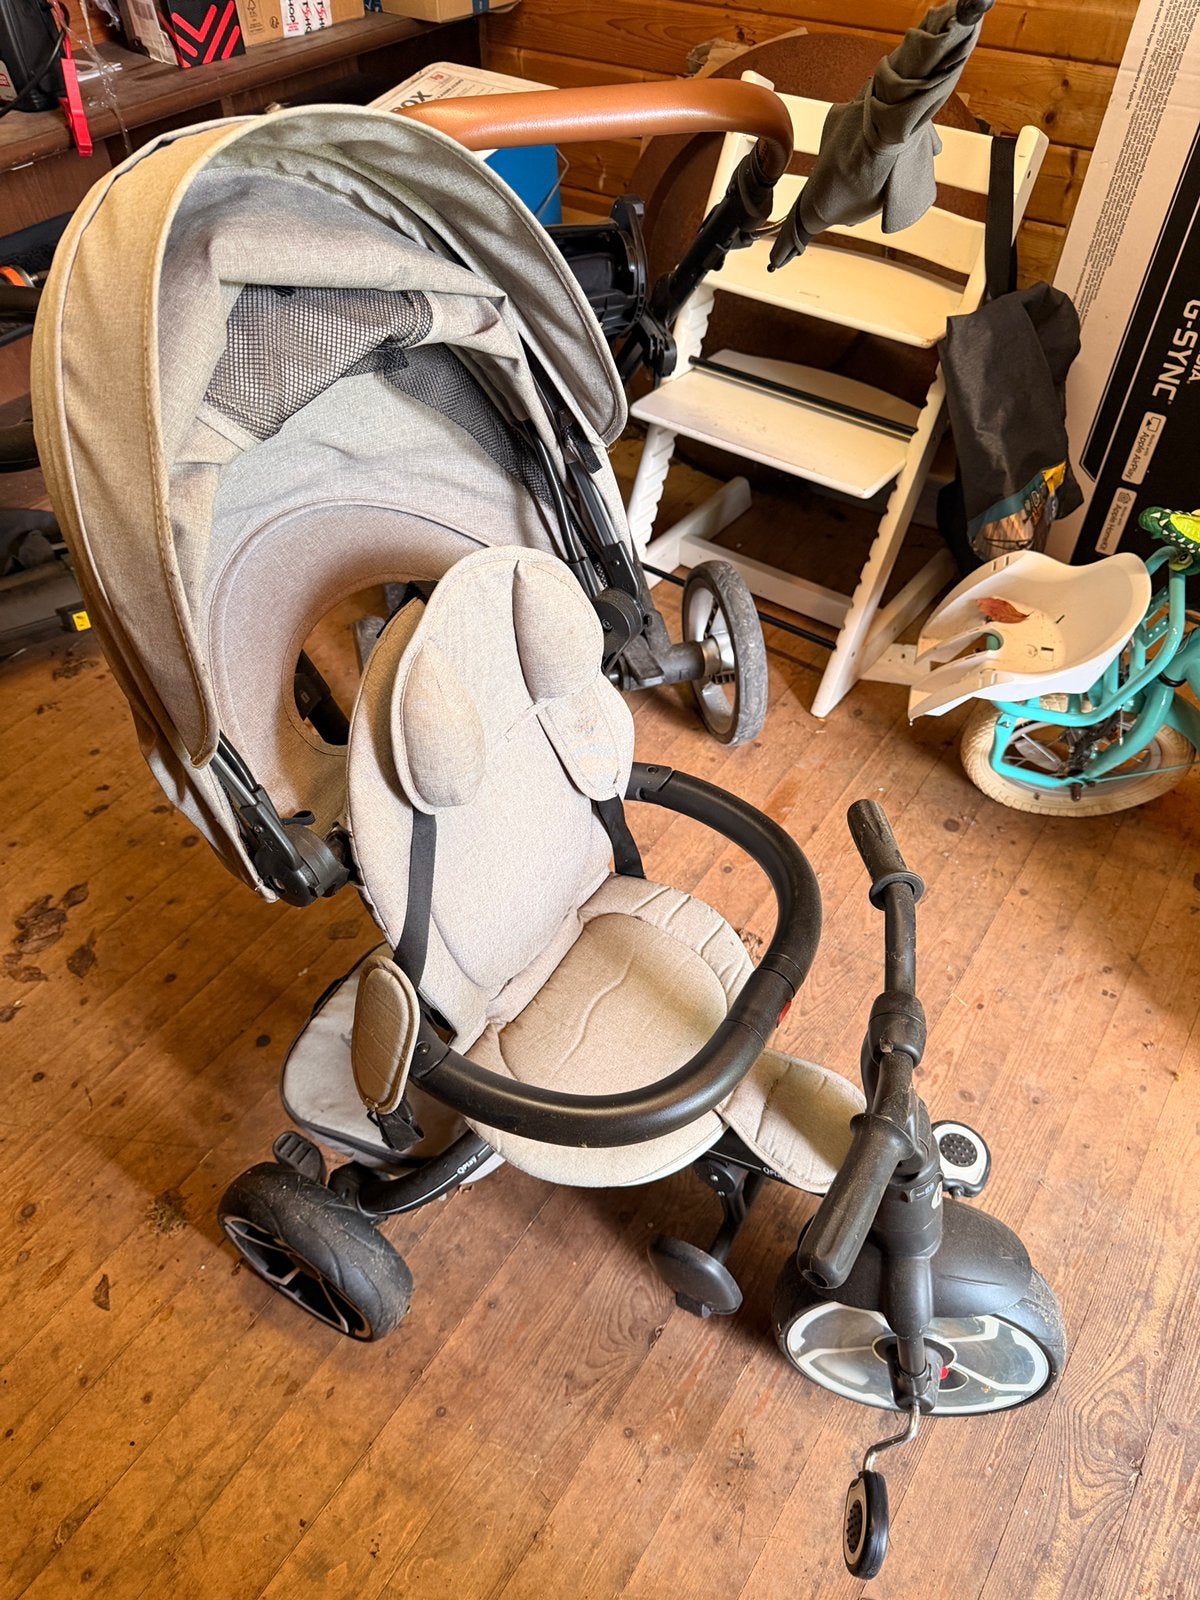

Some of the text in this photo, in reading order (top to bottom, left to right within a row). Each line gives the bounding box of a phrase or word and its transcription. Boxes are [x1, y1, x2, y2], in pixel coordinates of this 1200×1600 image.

[390, 91, 432, 112] OX
[1152, 299, 1200, 400] G-SYNC
[1125, 432, 1150, 480] Apple AirPlay
[1109, 504, 1122, 525] Apple
